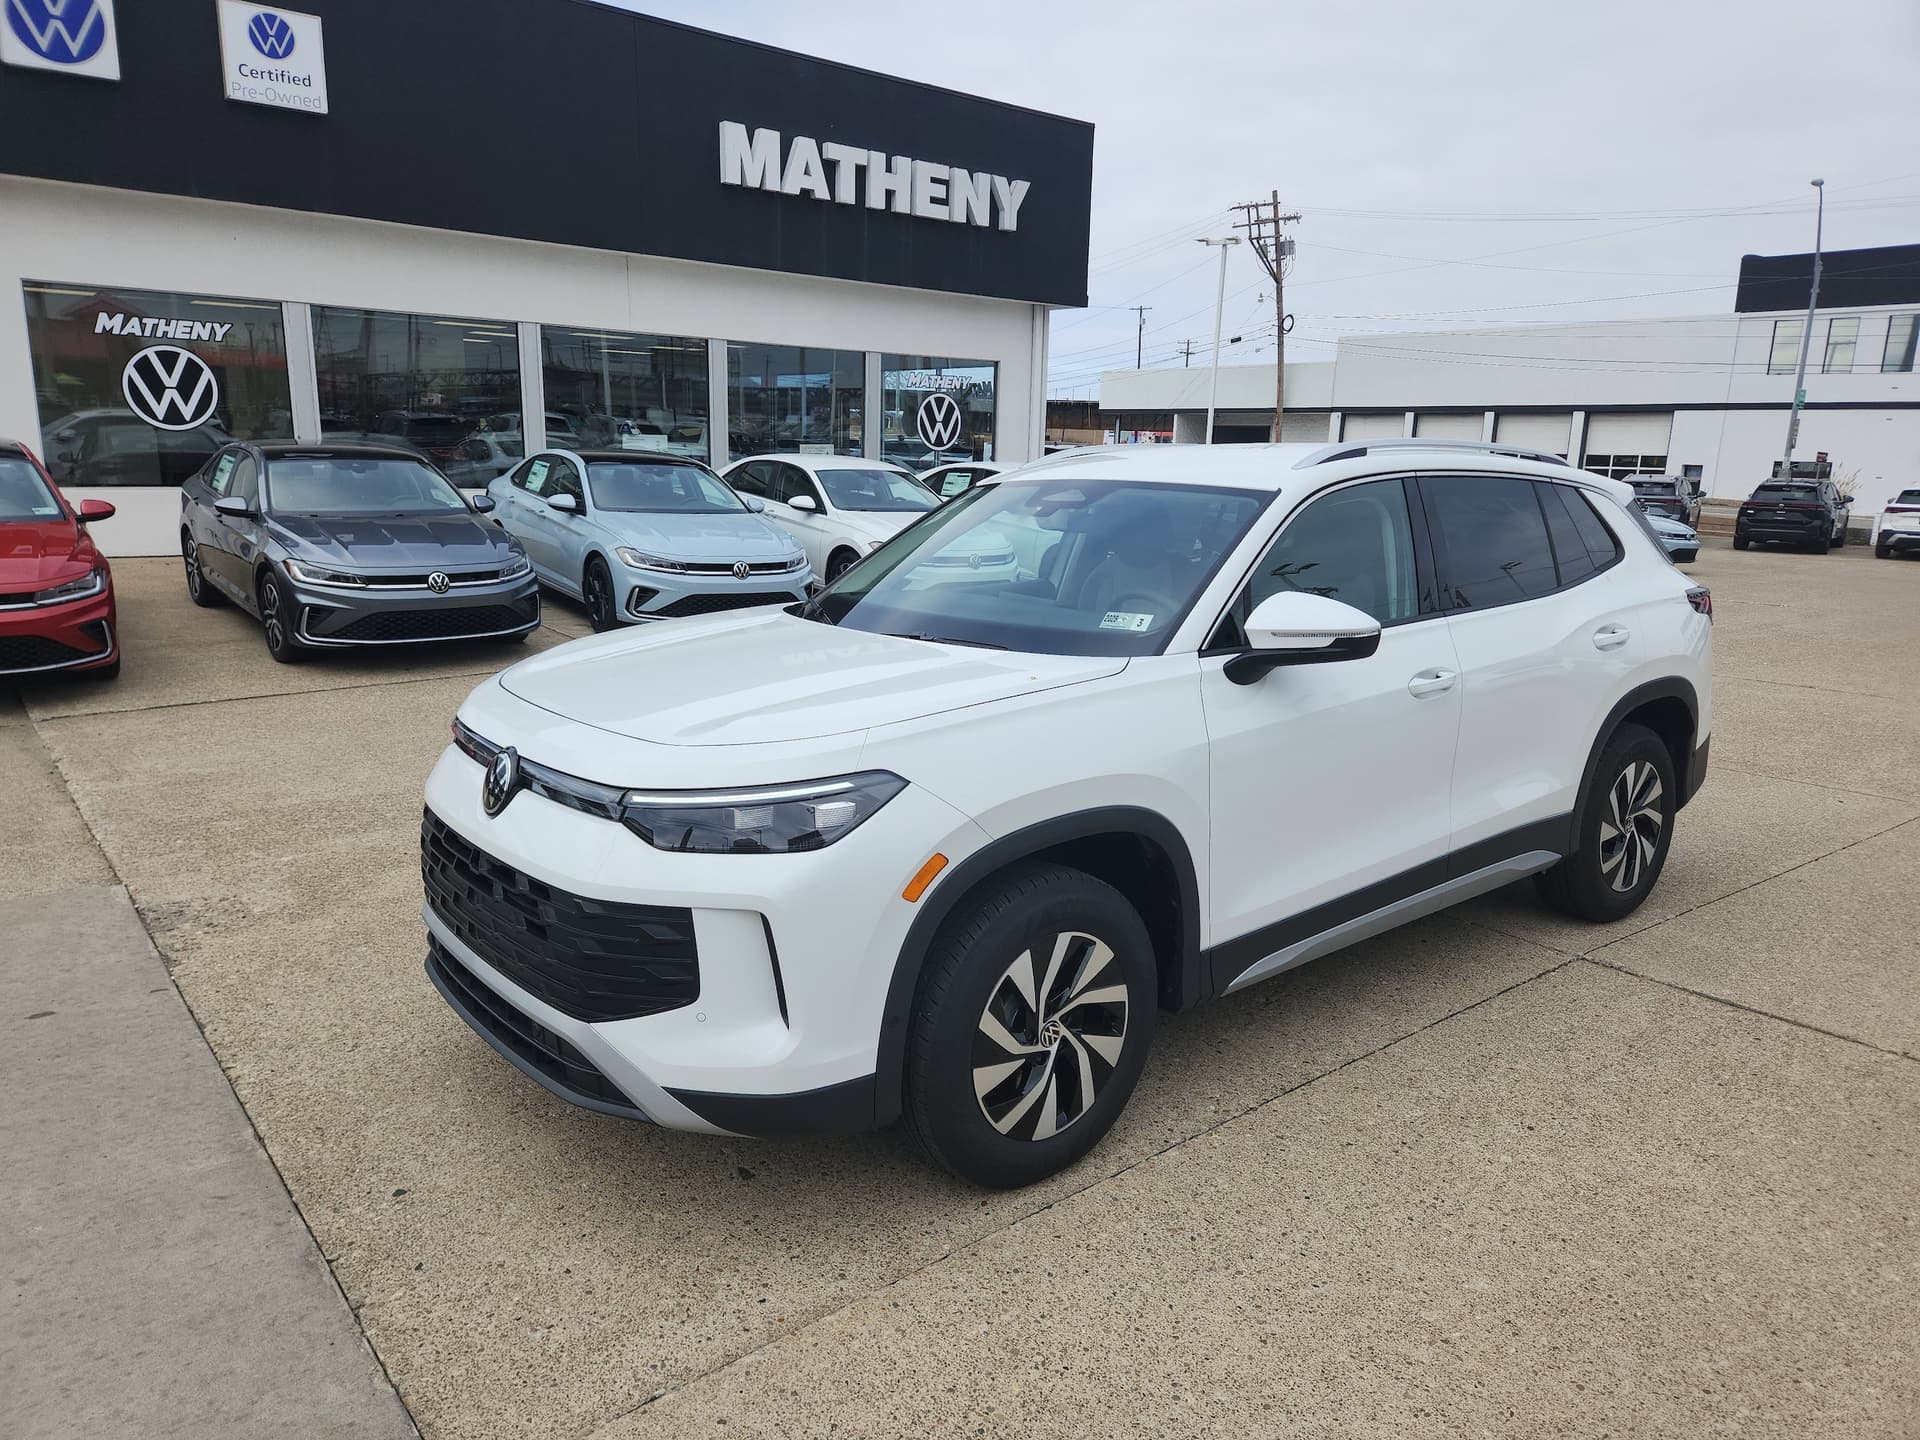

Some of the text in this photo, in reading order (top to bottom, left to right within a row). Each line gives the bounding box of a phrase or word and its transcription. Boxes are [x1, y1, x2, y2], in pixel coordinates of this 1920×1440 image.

[249, 13, 295, 59] VW
[238, 63, 312, 87] Certified
[231, 82, 321, 109] Pre-Owned
[719, 120, 1032, 232] MATHENY
[94, 311, 232, 342] MATHENY
[122, 345, 218, 430] VW
[907, 372, 971, 390] MATHENY
[918, 393, 961, 450] VW
